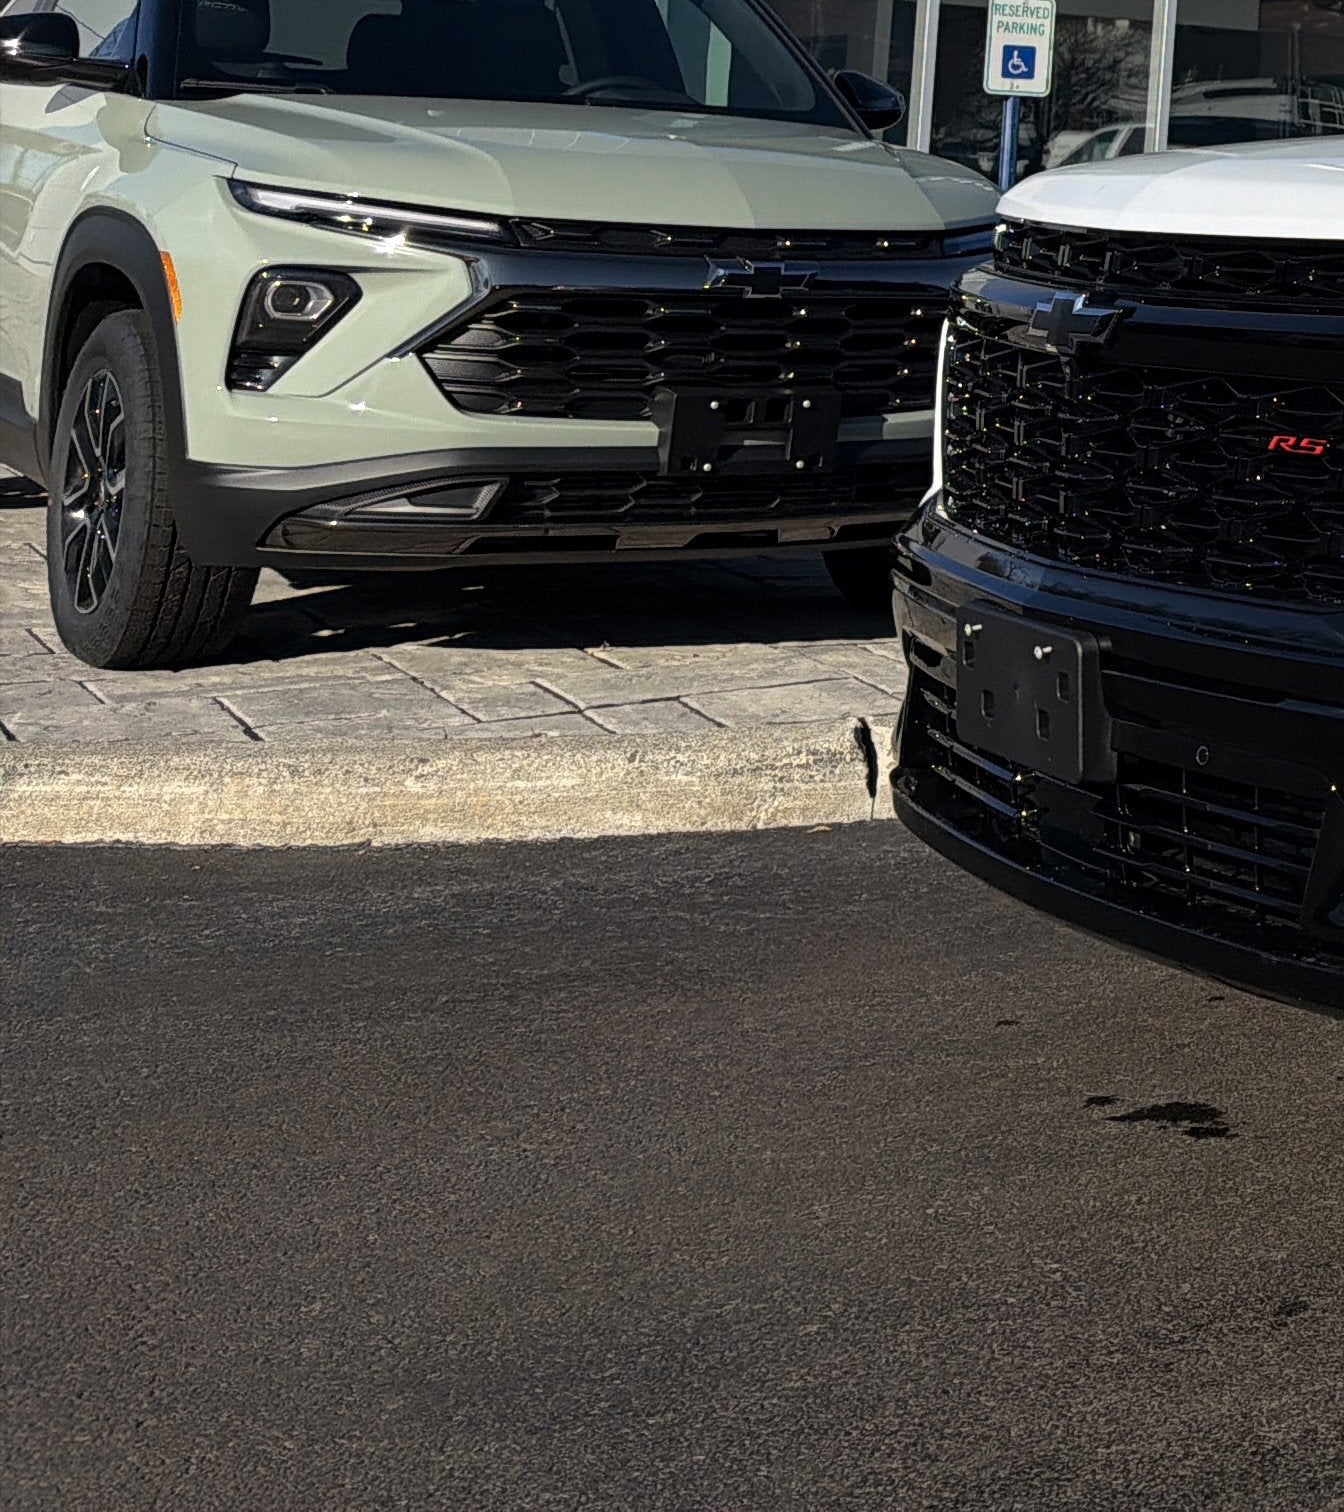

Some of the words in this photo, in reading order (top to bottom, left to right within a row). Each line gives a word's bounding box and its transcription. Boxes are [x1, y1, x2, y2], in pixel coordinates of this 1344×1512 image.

[994, 3, 1050, 20] RESERVED
[996, 20, 1046, 37] PARKING
[1267, 434, 1328, 456] RS
